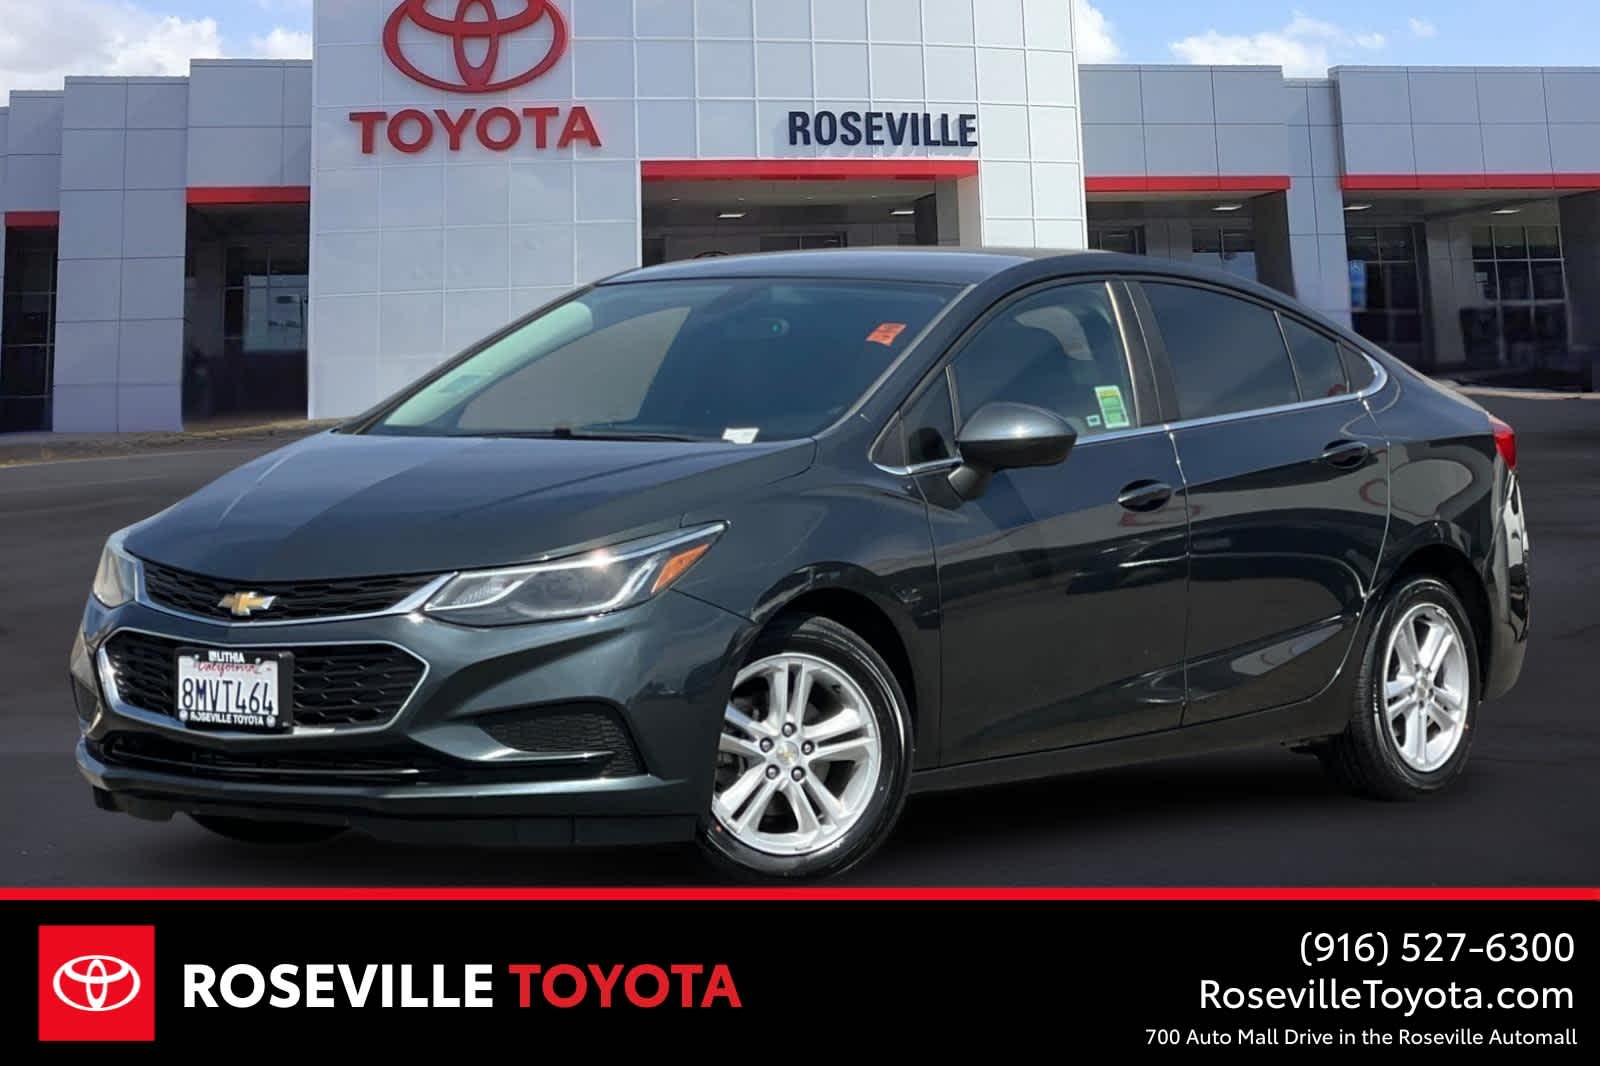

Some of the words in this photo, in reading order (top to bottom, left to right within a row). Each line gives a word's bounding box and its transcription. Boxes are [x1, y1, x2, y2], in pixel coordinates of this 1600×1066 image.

[349, 106, 602, 154] TOYOTA
[788, 110, 979, 147] ROSEVILLE
[182, 677, 274, 715] 8MVT464
[190, 711, 232, 723] ROSEVILLE
[233, 714, 265, 726] TOYOTA
